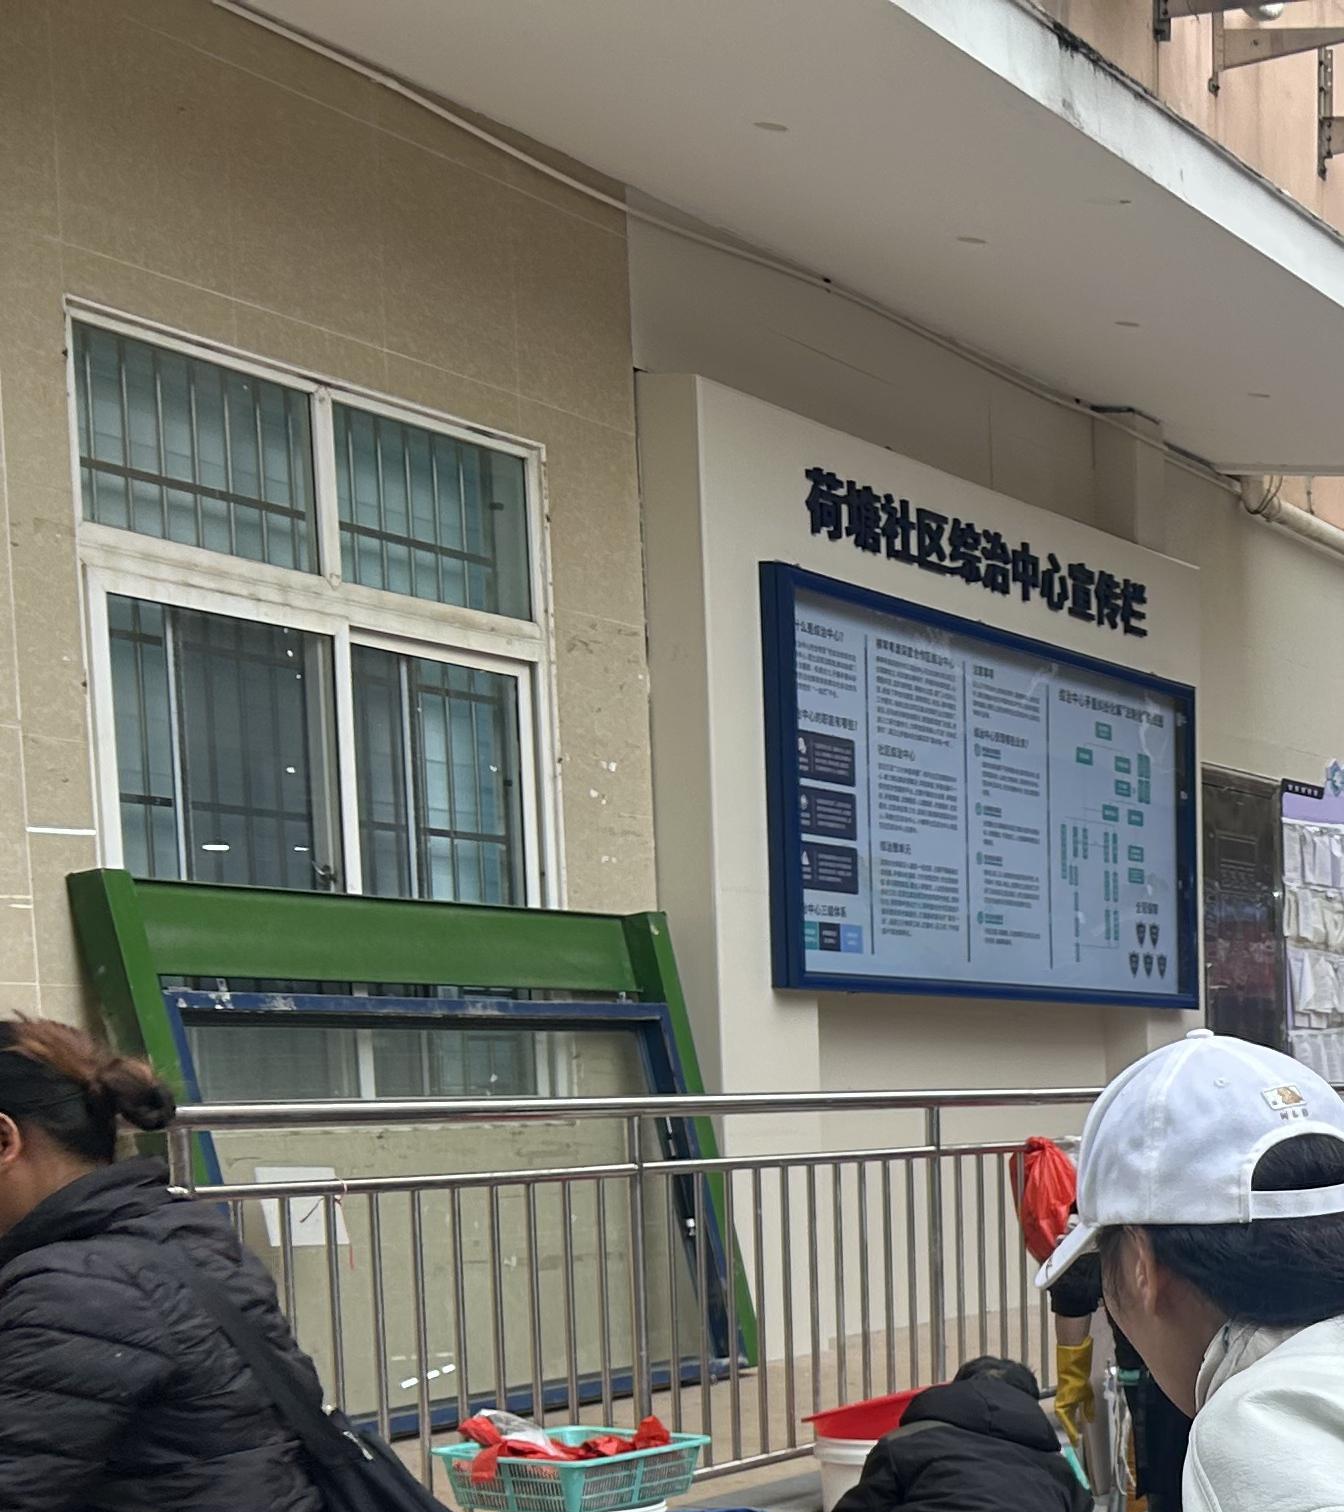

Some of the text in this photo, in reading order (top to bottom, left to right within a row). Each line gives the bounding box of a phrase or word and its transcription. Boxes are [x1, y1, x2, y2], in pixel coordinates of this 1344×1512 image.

[804, 467, 1148, 637] 荷塘社区综治中心宣传栏
